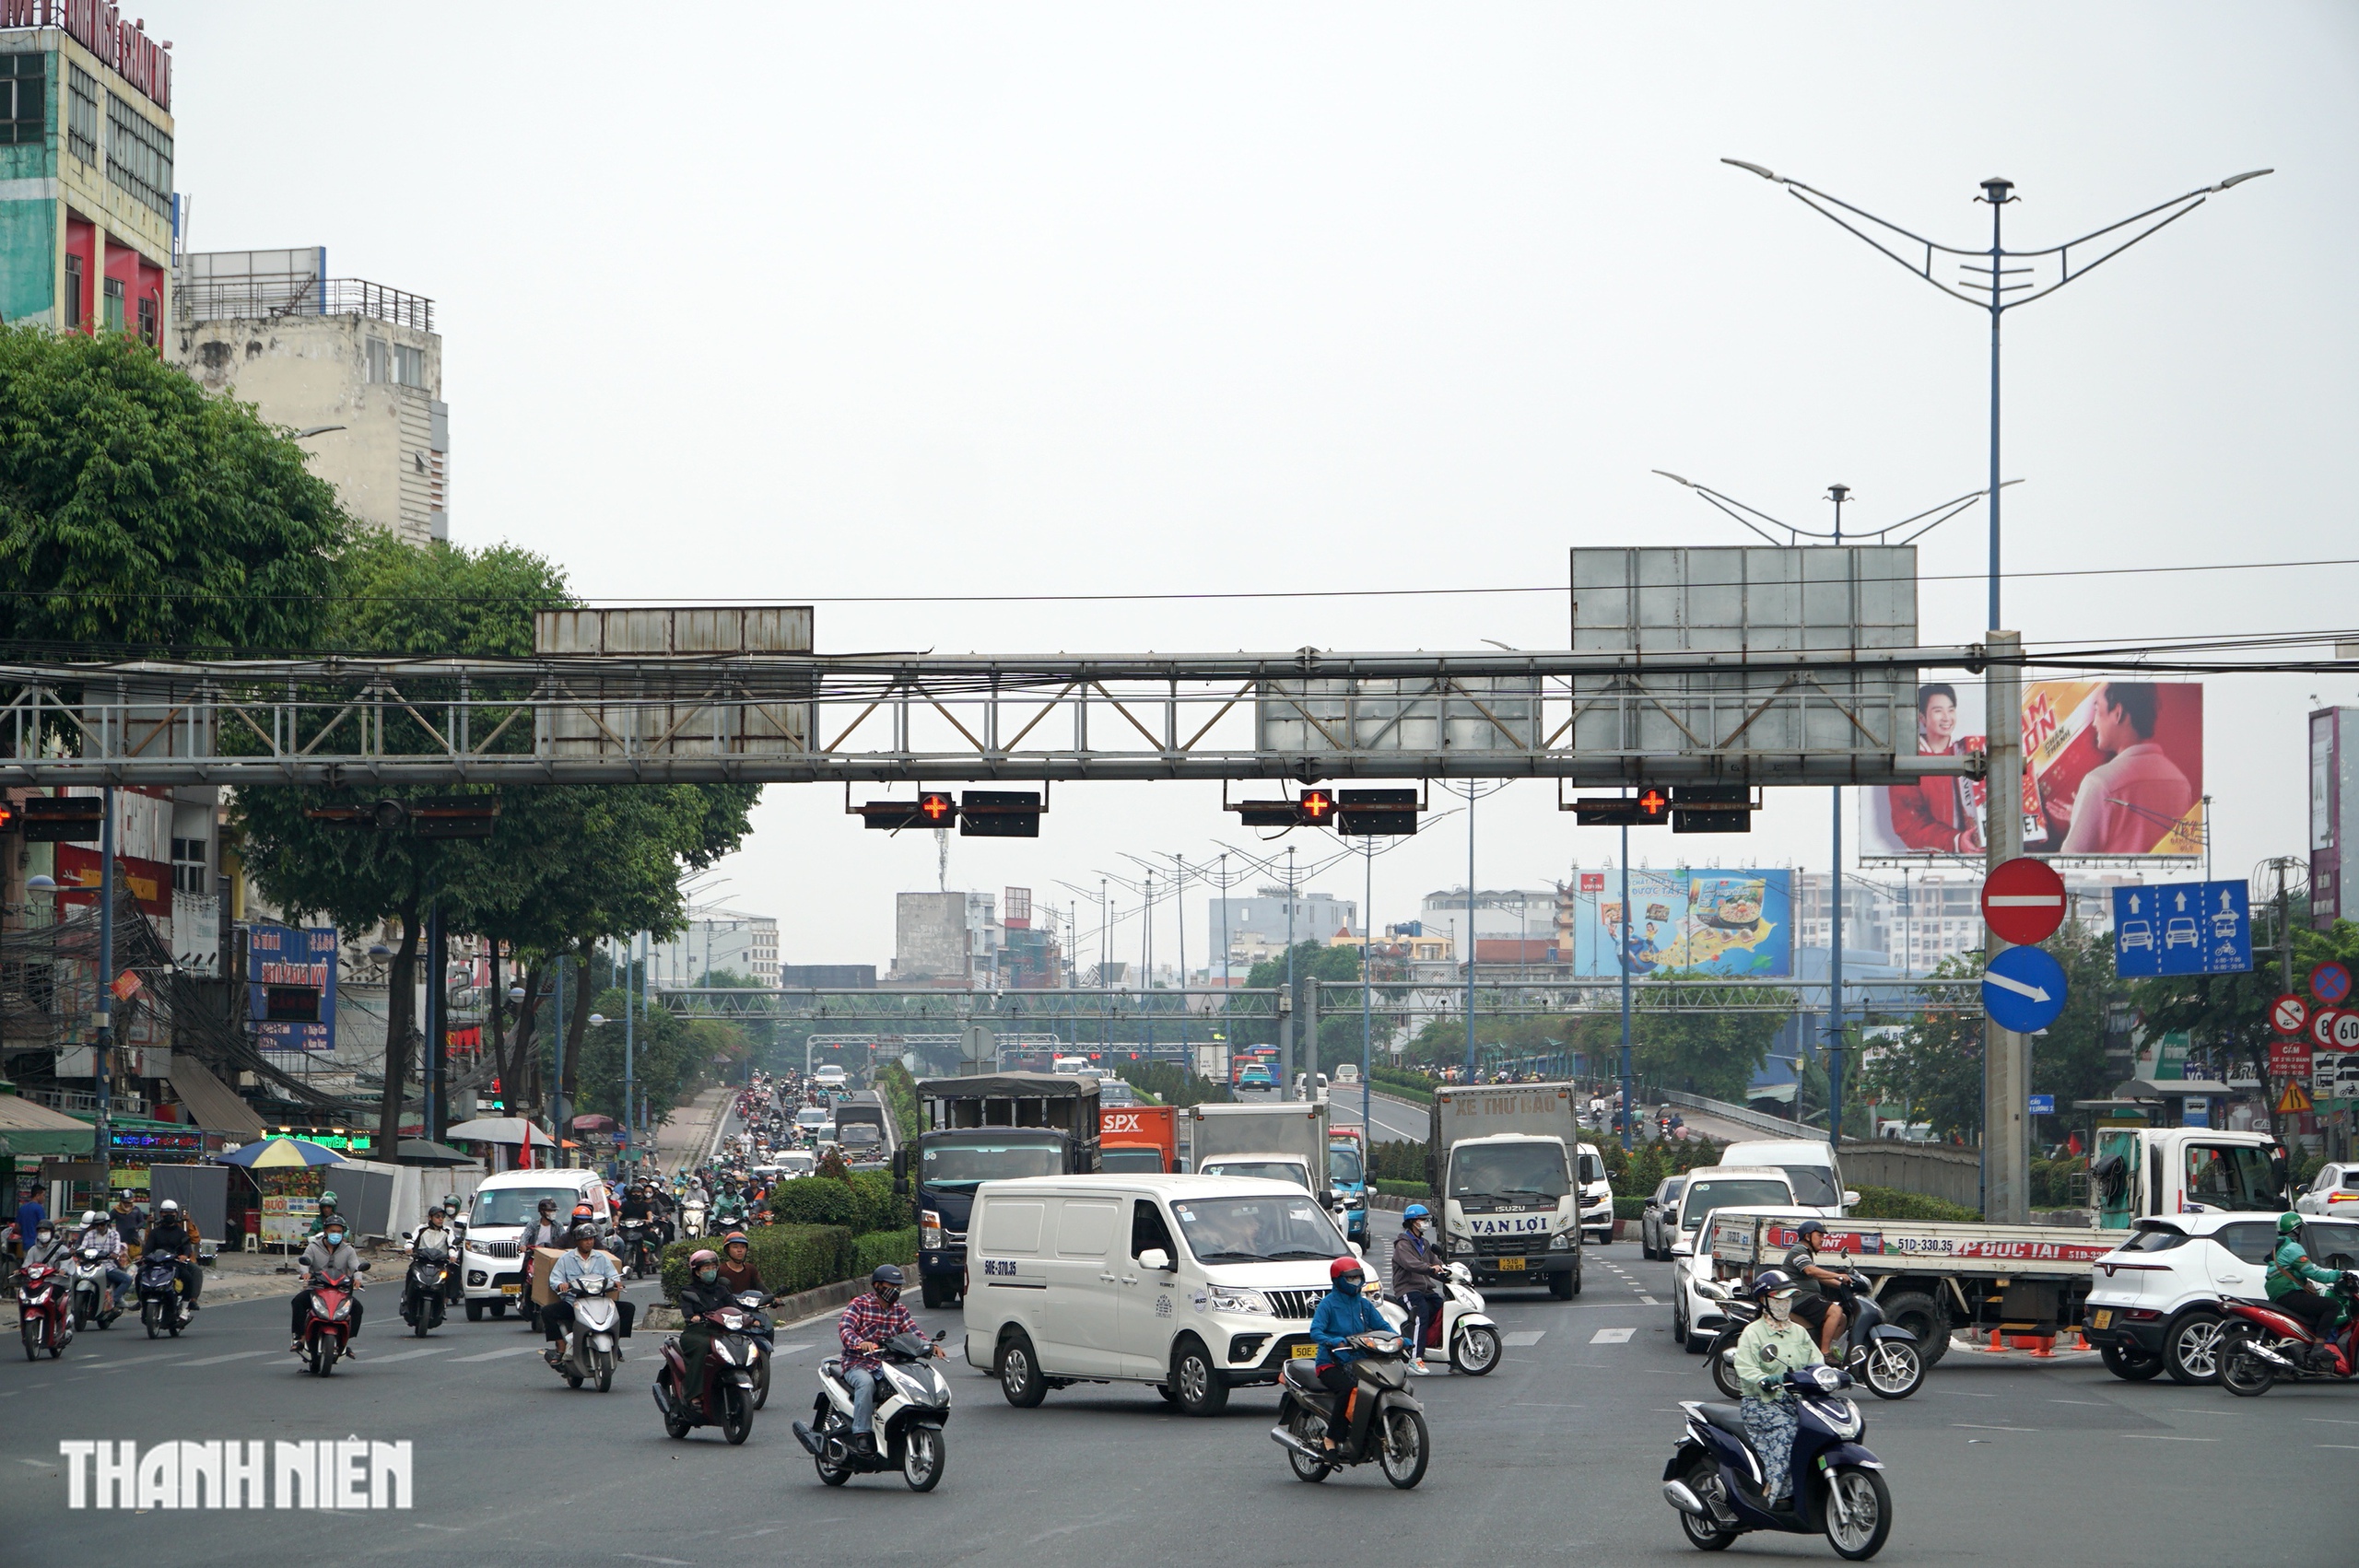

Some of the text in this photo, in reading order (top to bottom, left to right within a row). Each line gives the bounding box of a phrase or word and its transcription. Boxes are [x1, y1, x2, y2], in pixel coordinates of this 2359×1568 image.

[2340, 1022, 2359, 1040] 60
[2283, 1043, 2300, 1055] CẤM
[1456, 1098, 1477, 1117] XE
[1484, 1095, 1518, 1115] THƯ
[1103, 1114, 1140, 1133] SPX
[1471, 1216, 1547, 1235] VẠN LỢI
[1897, 1238, 1954, 1251] 51D-330.35
[985, 1260, 1016, 1276] 50E-370.35
